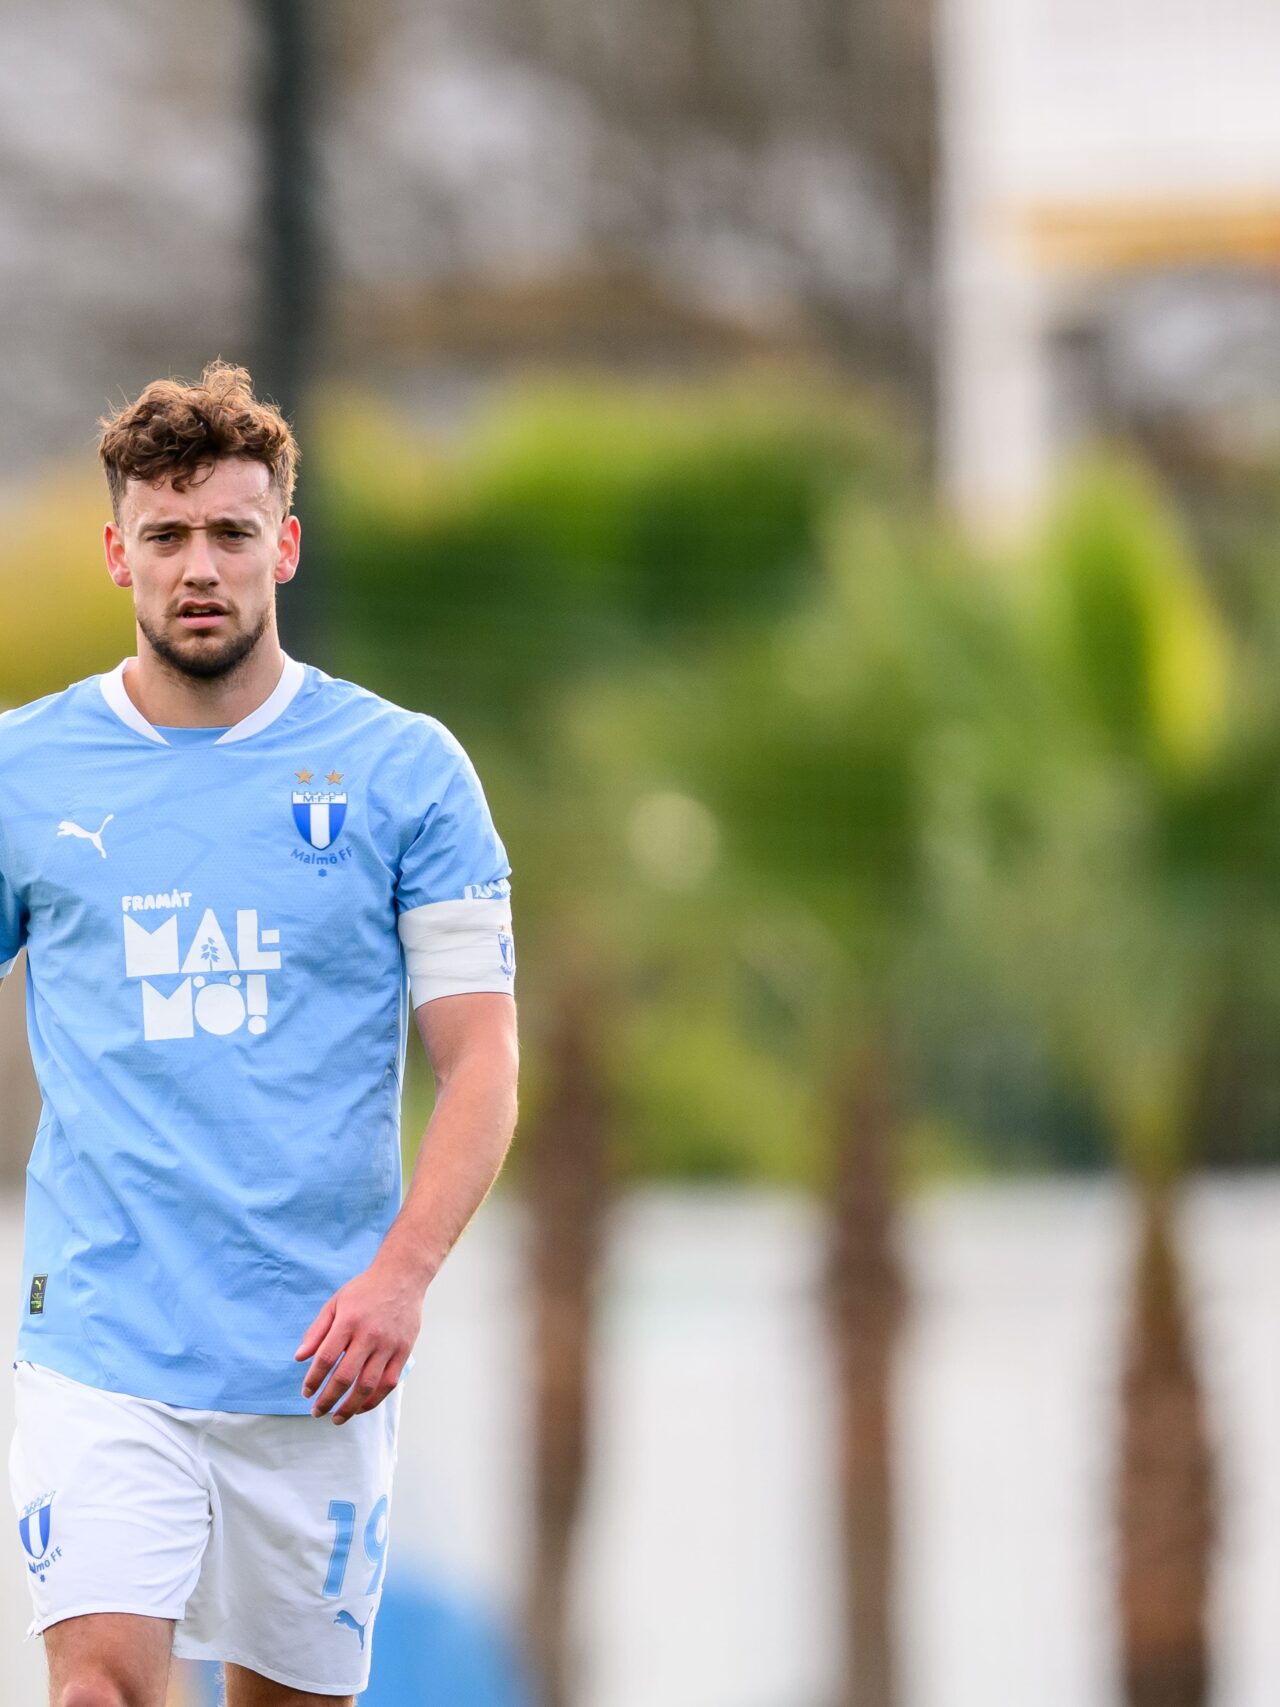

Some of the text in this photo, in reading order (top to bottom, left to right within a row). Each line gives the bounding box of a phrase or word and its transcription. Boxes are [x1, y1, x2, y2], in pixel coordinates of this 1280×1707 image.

[290, 846, 353, 865] Malmö FF
[122, 889, 192, 912] FRAMÅT
[141, 974, 268, 1041] MÖ!
[50, 1546, 63, 1562] FF
[322, 1494, 389, 1597] 19
